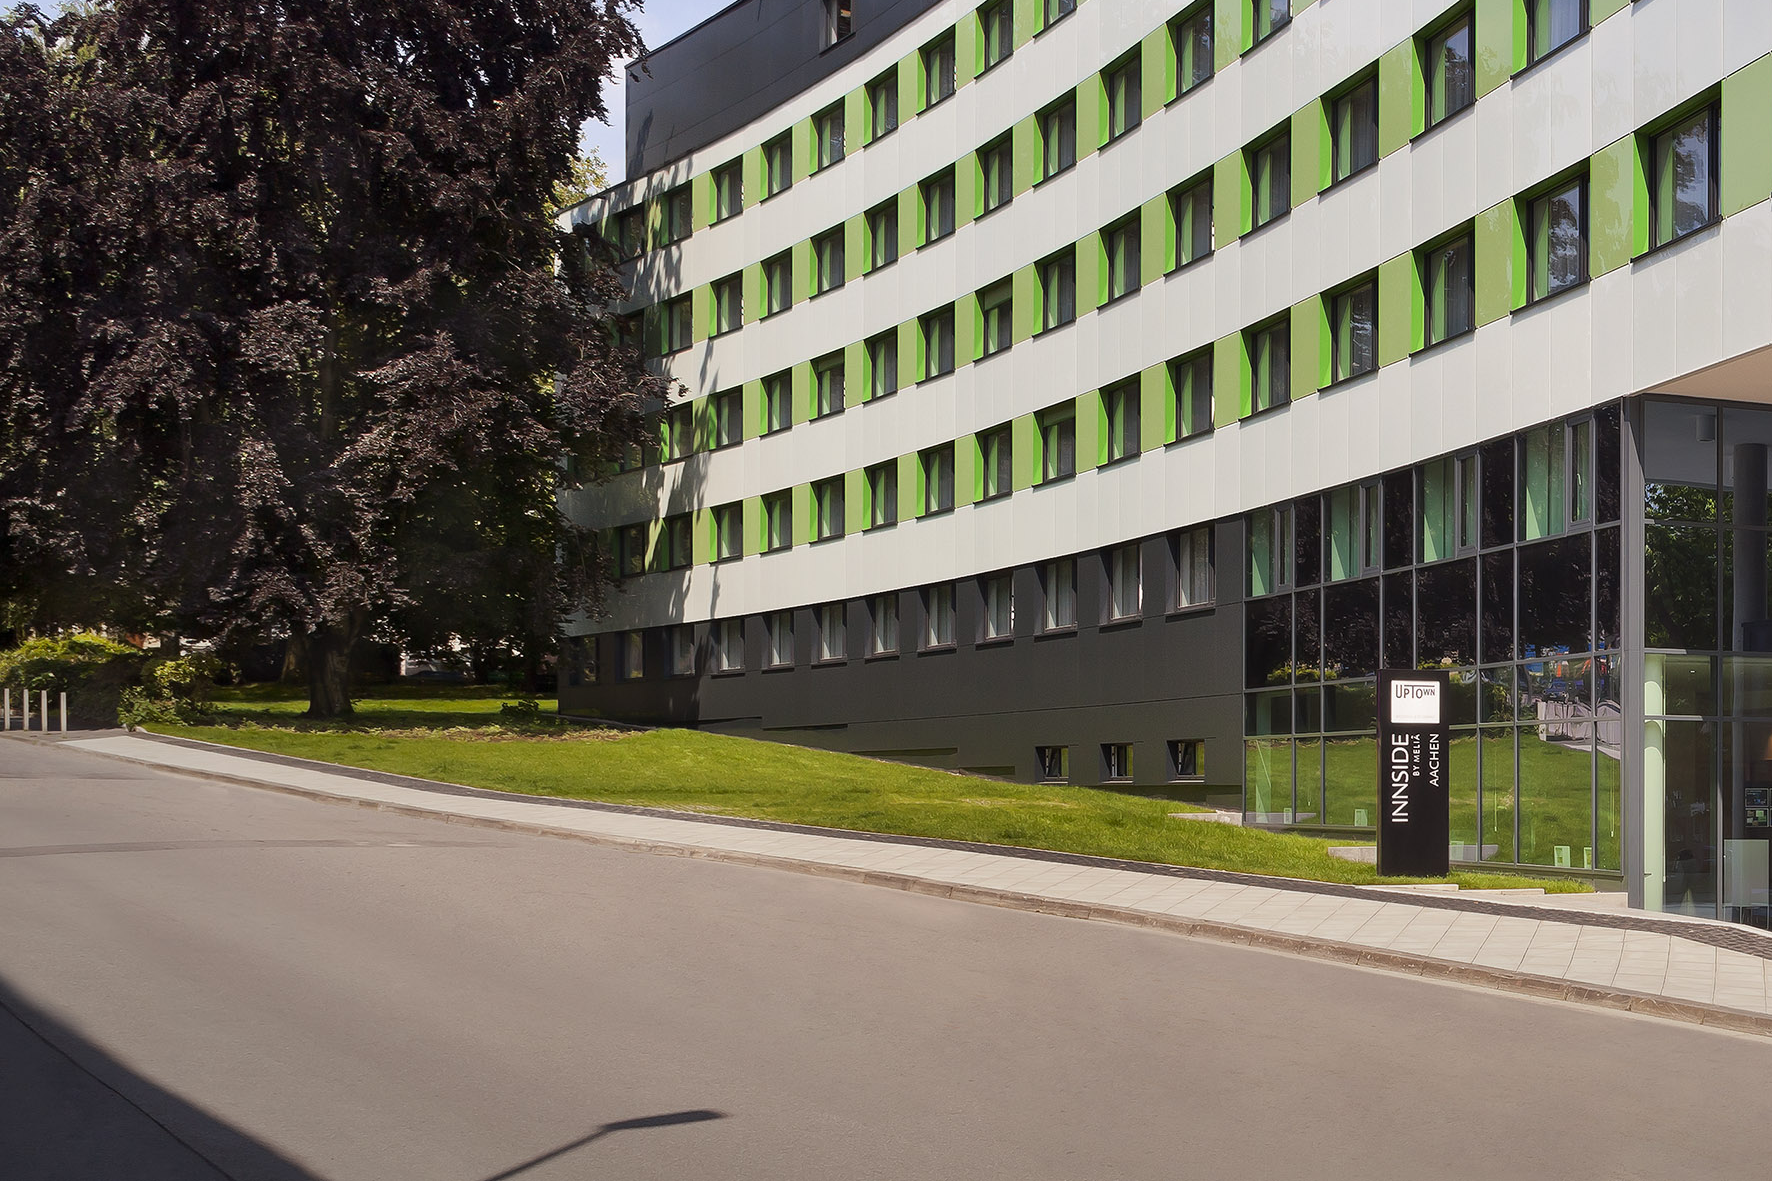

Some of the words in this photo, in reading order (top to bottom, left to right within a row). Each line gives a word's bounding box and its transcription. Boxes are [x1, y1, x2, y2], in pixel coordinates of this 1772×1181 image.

[1391, 733, 1409, 823] INNSIDE
[1412, 765, 1420, 777] BY
[1429, 733, 1440, 787] AACHEN
